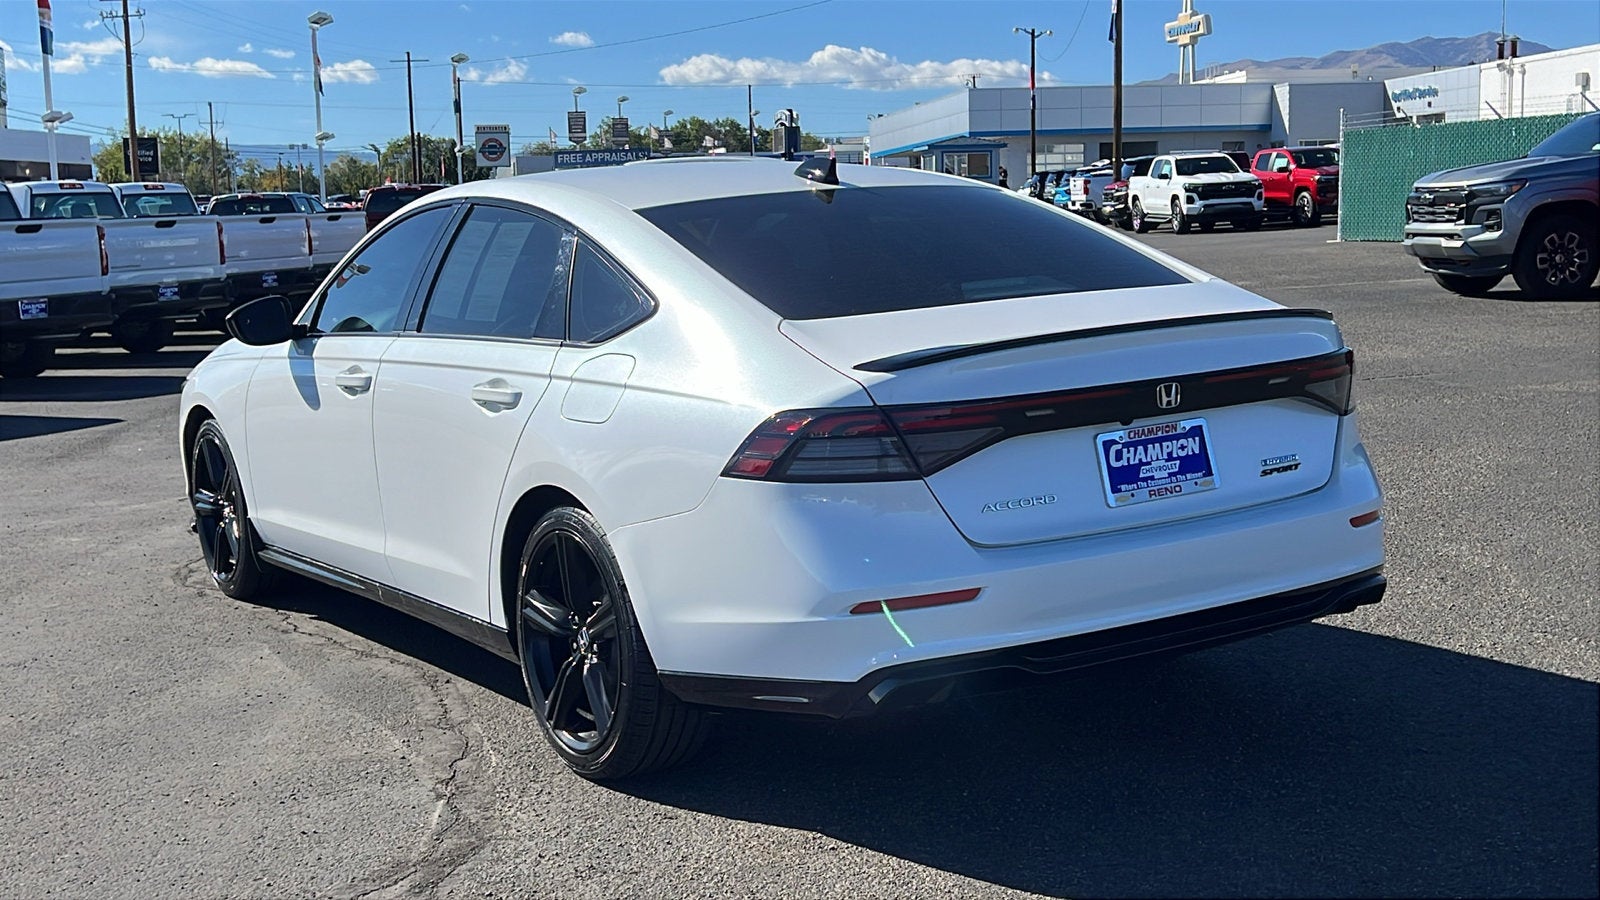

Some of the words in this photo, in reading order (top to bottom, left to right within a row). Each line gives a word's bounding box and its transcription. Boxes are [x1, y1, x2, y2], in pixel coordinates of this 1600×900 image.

[1168, 20, 1201, 38] CHEVROLET
[557, 153, 583, 164] FREE
[1127, 423, 1178, 440] CHAMPION
[1109, 437, 1200, 468] CHAMPION
[1141, 462, 1179, 475] CHEVROLET
[1260, 463, 1301, 477] SPORT
[1138, 480, 1148, 488] The
[1147, 477, 1171, 487] Customer
[1148, 484, 1183, 499] RENO
[981, 495, 1058, 513] ACCORD
